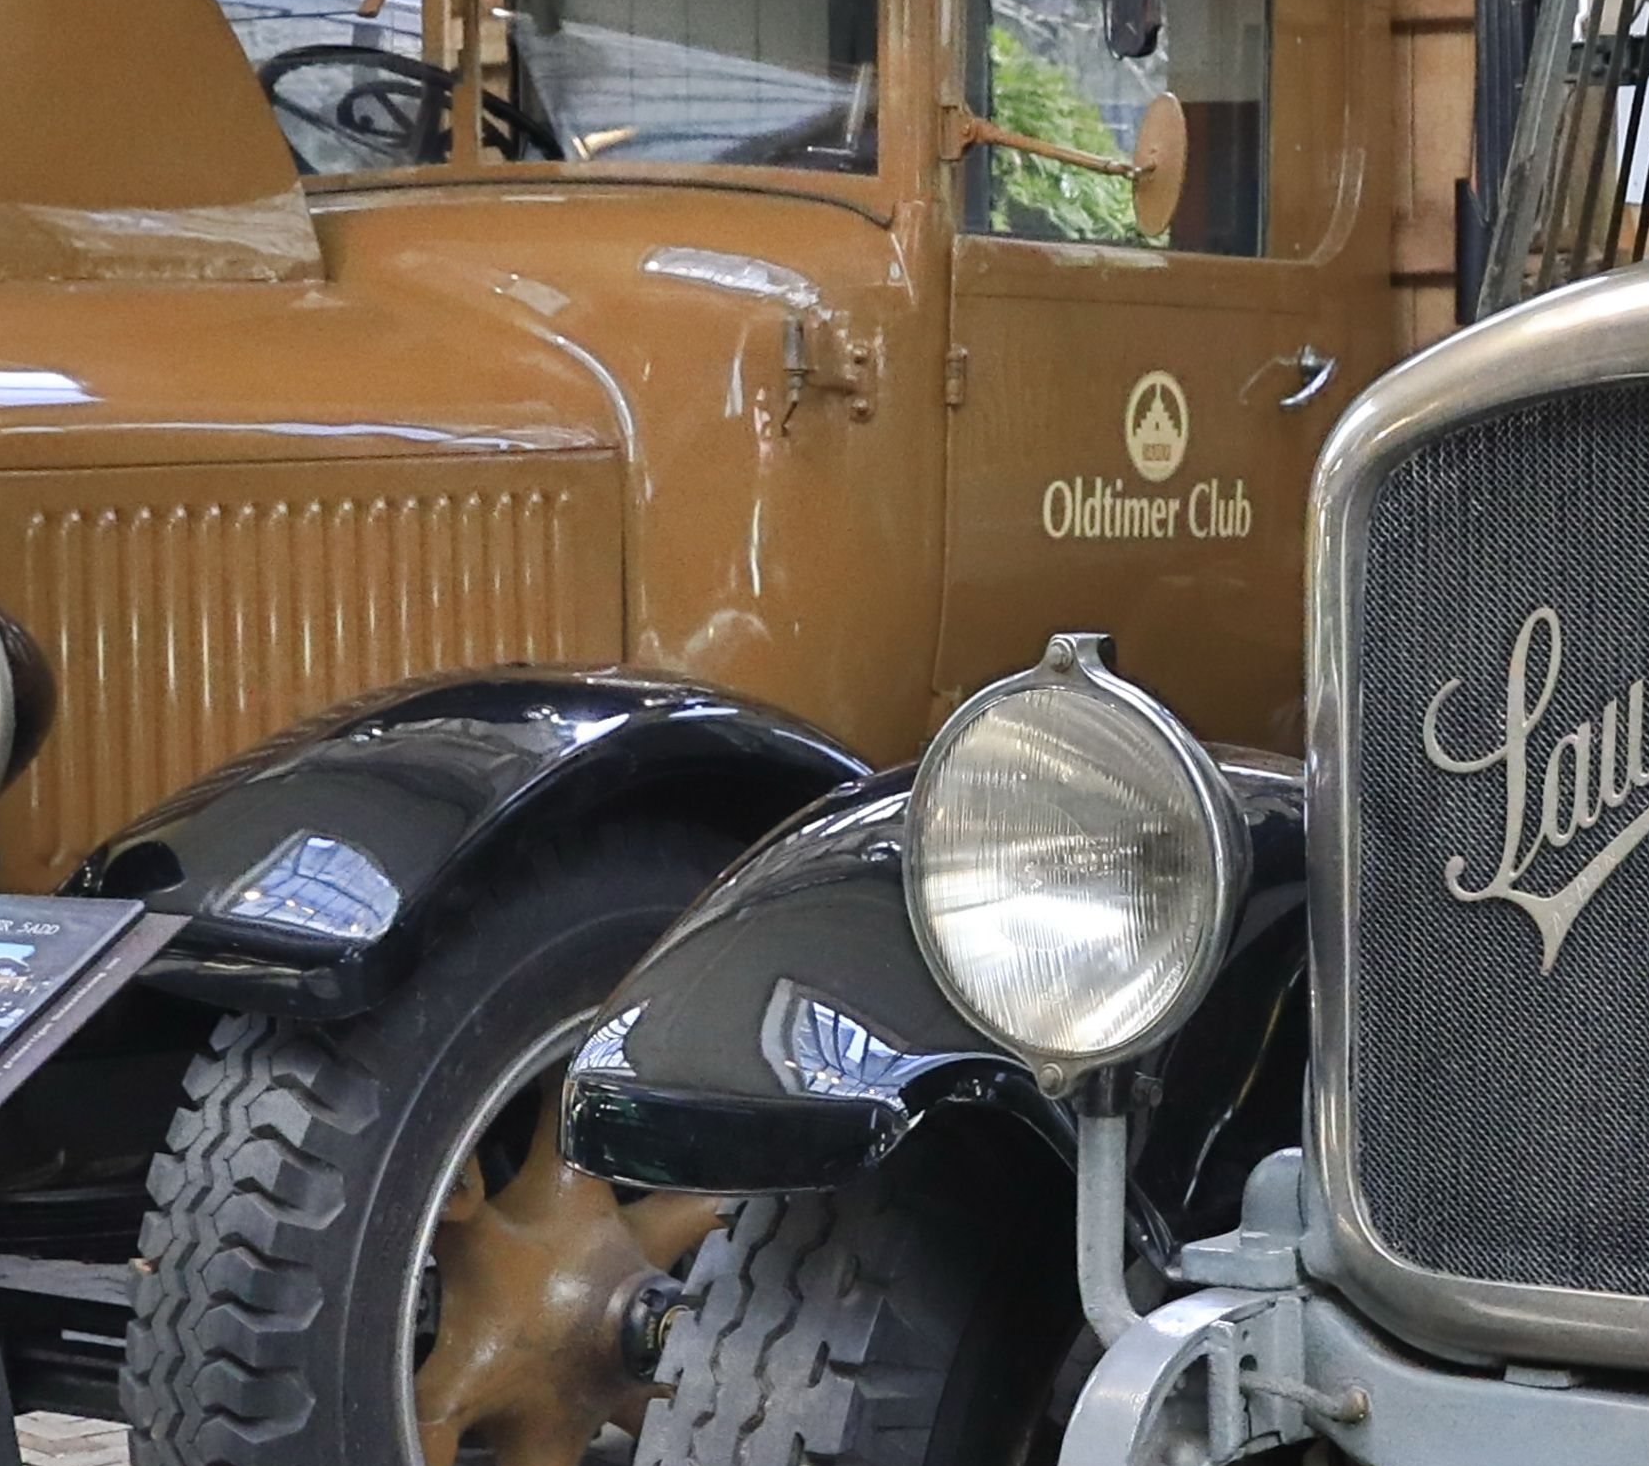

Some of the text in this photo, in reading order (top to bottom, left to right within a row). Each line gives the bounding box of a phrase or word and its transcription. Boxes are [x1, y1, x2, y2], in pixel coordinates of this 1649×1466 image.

[1043, 477, 1251, 538] Oldtimer Club
[17, 922, 60, 935] 5ADD
